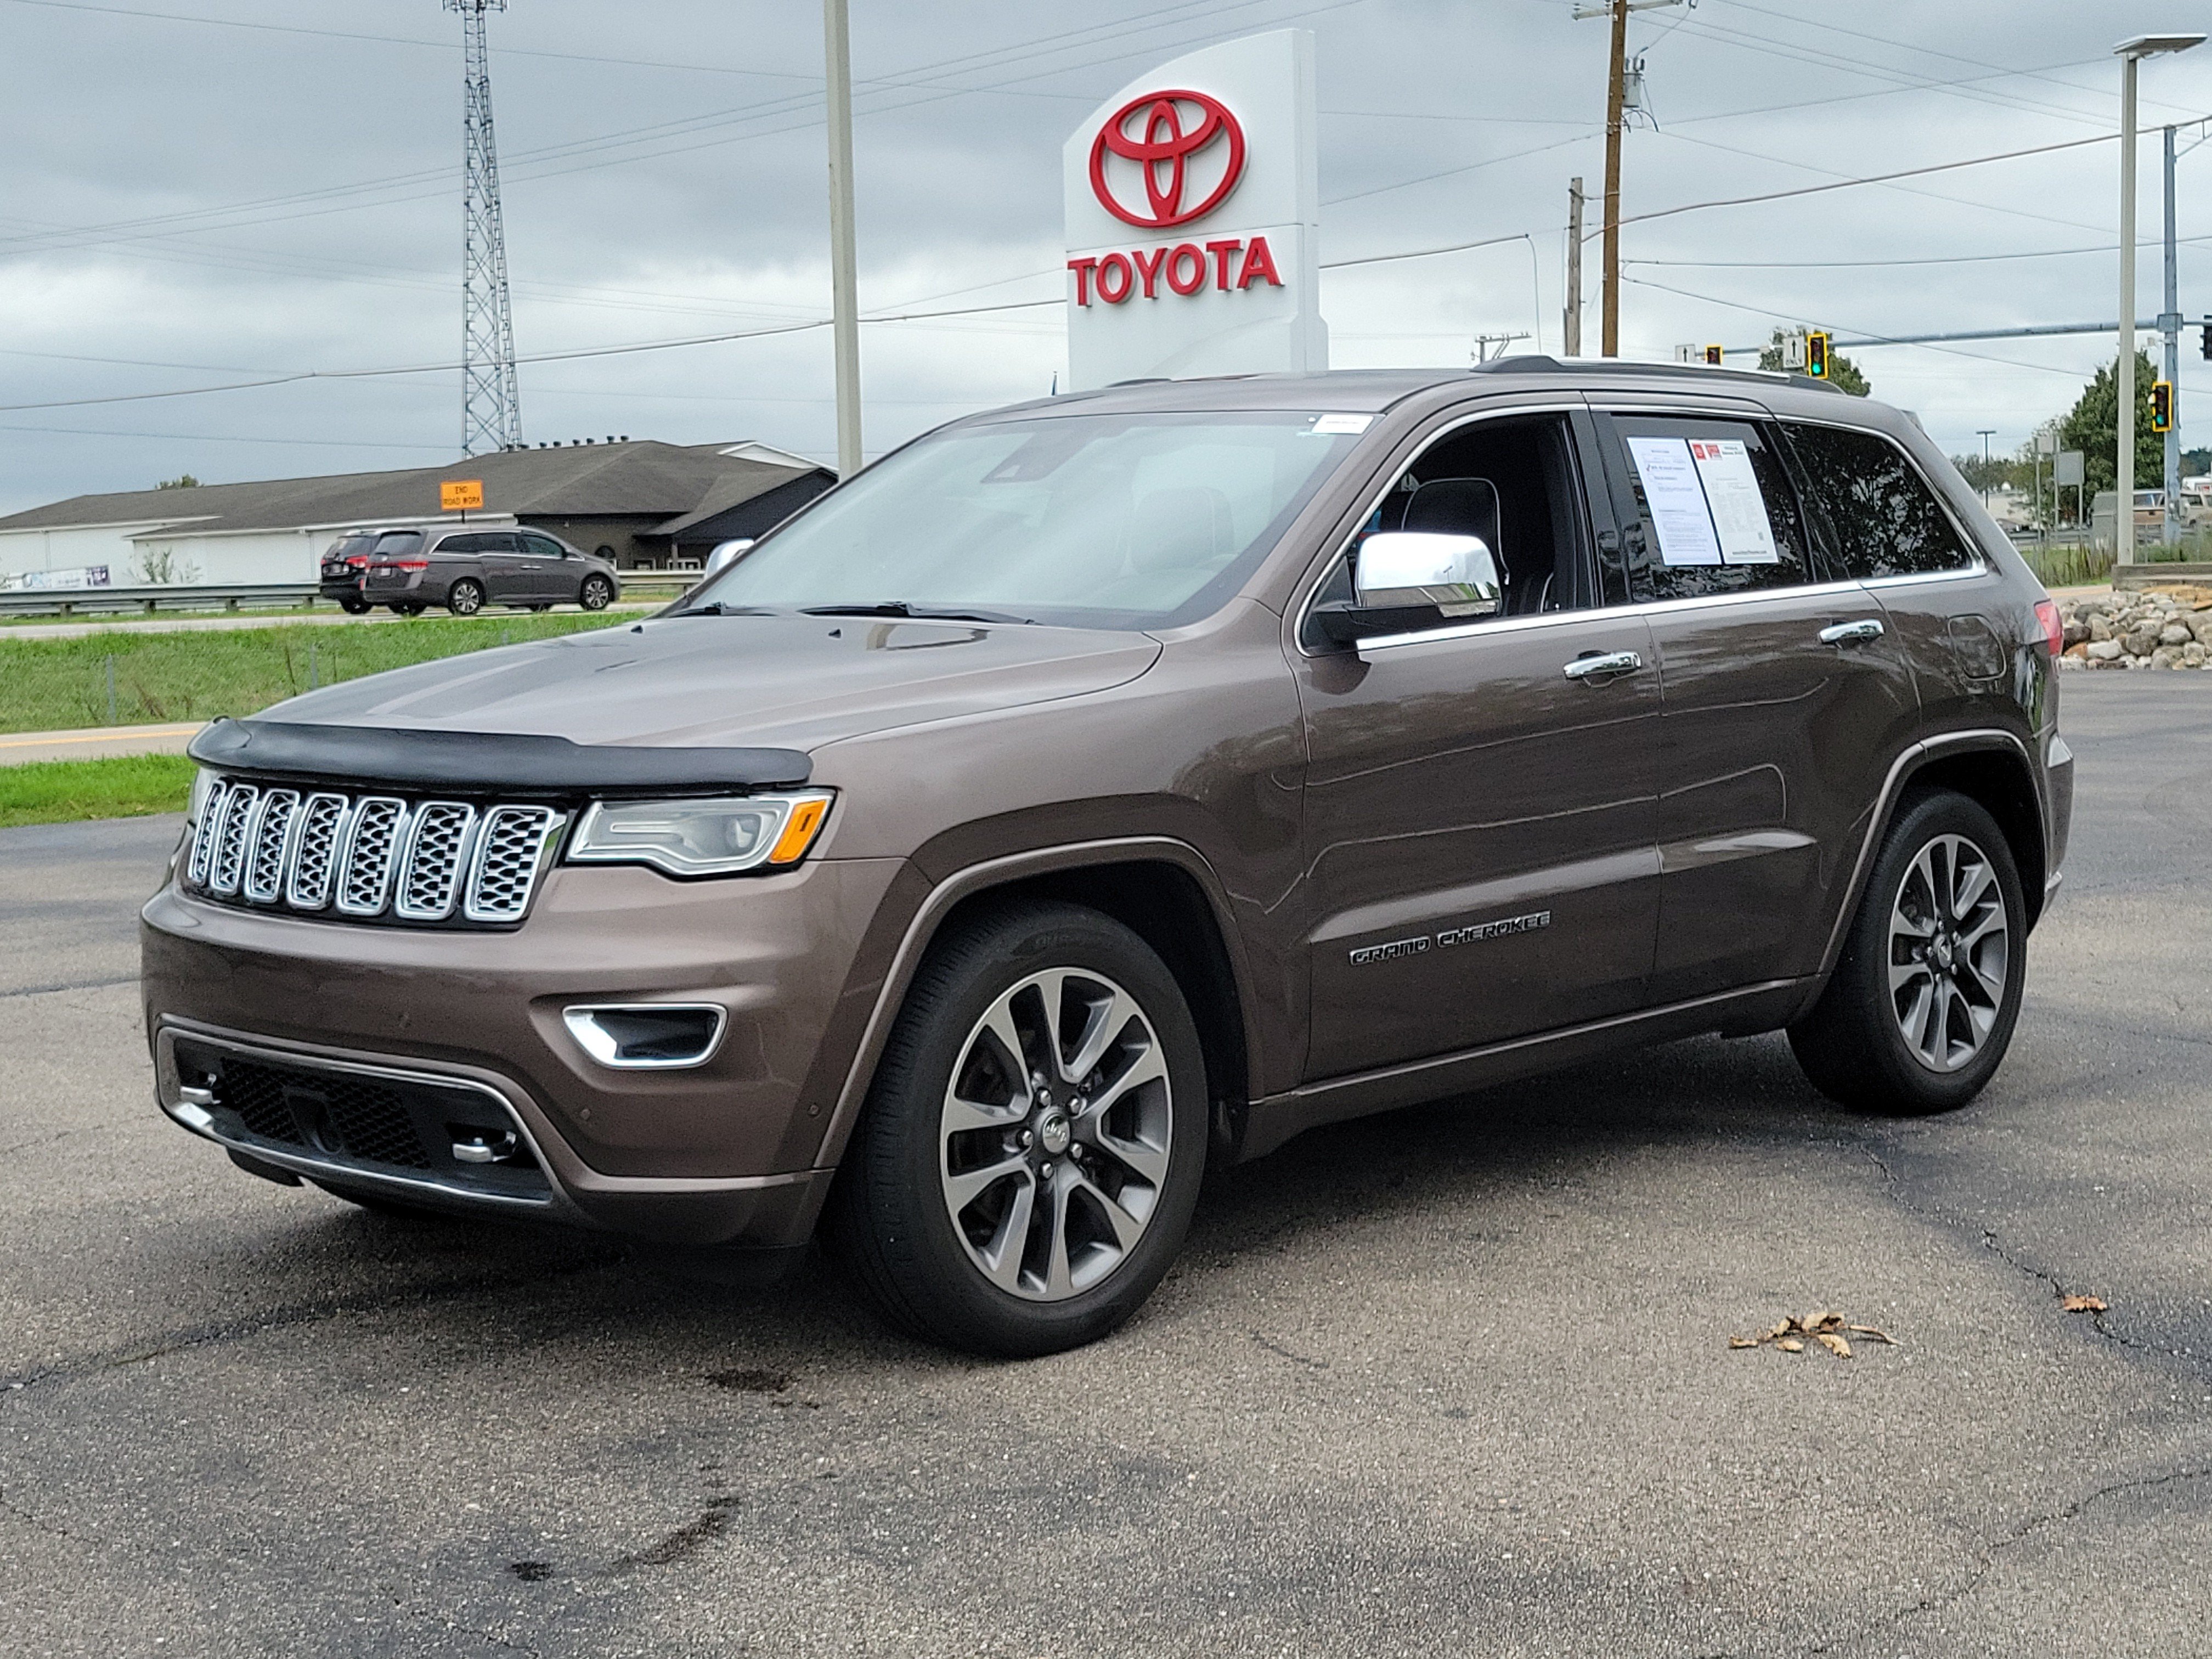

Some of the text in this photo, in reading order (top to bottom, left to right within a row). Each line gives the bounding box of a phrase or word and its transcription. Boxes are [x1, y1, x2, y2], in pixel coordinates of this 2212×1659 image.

[1067, 236, 1285, 307] TOYOTA
[443, 496, 482, 506] ROAD WORK
[455, 486, 469, 495] END
[1348, 909, 1551, 966] GRAND CHEROKEE
